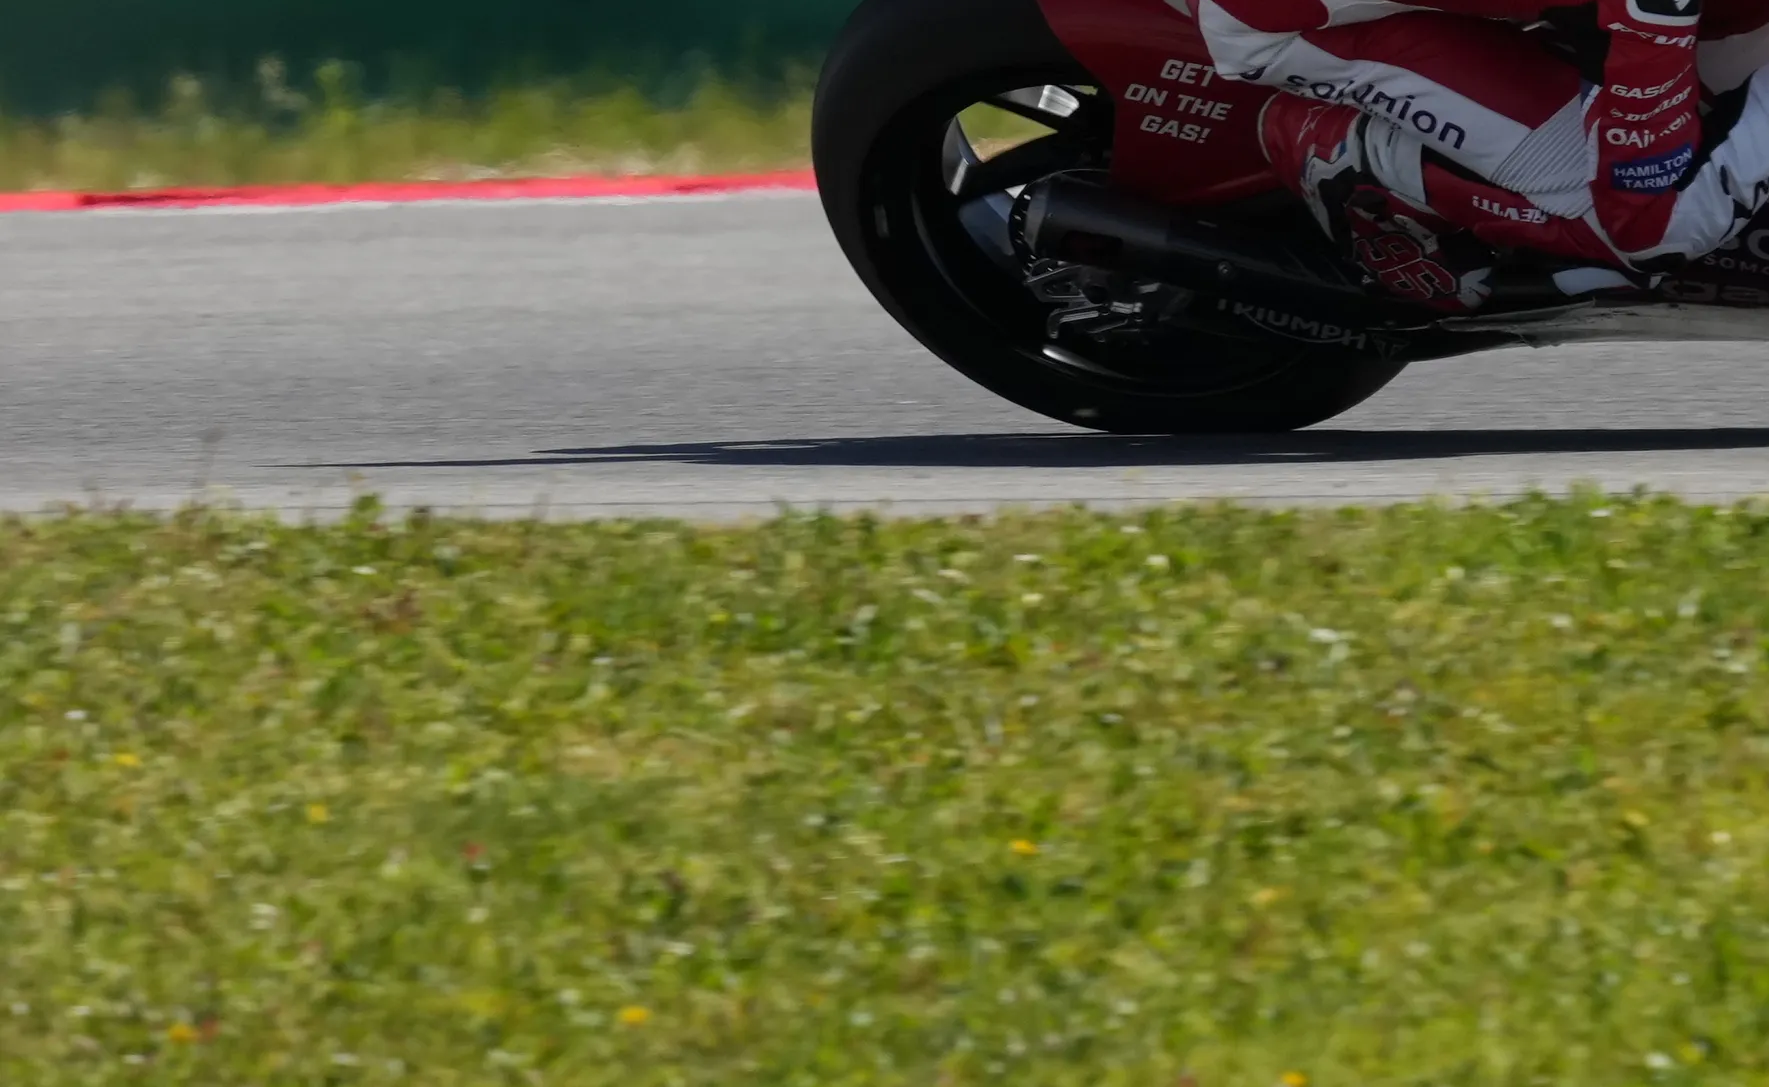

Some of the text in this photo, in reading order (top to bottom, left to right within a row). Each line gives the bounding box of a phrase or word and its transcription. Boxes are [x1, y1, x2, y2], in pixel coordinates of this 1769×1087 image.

[1161, 59, 1217, 88] GET
[1124, 83, 1233, 121] ON THE
[1140, 114, 1211, 144] GAS!
[1613, 148, 1693, 178] HAMILTON
